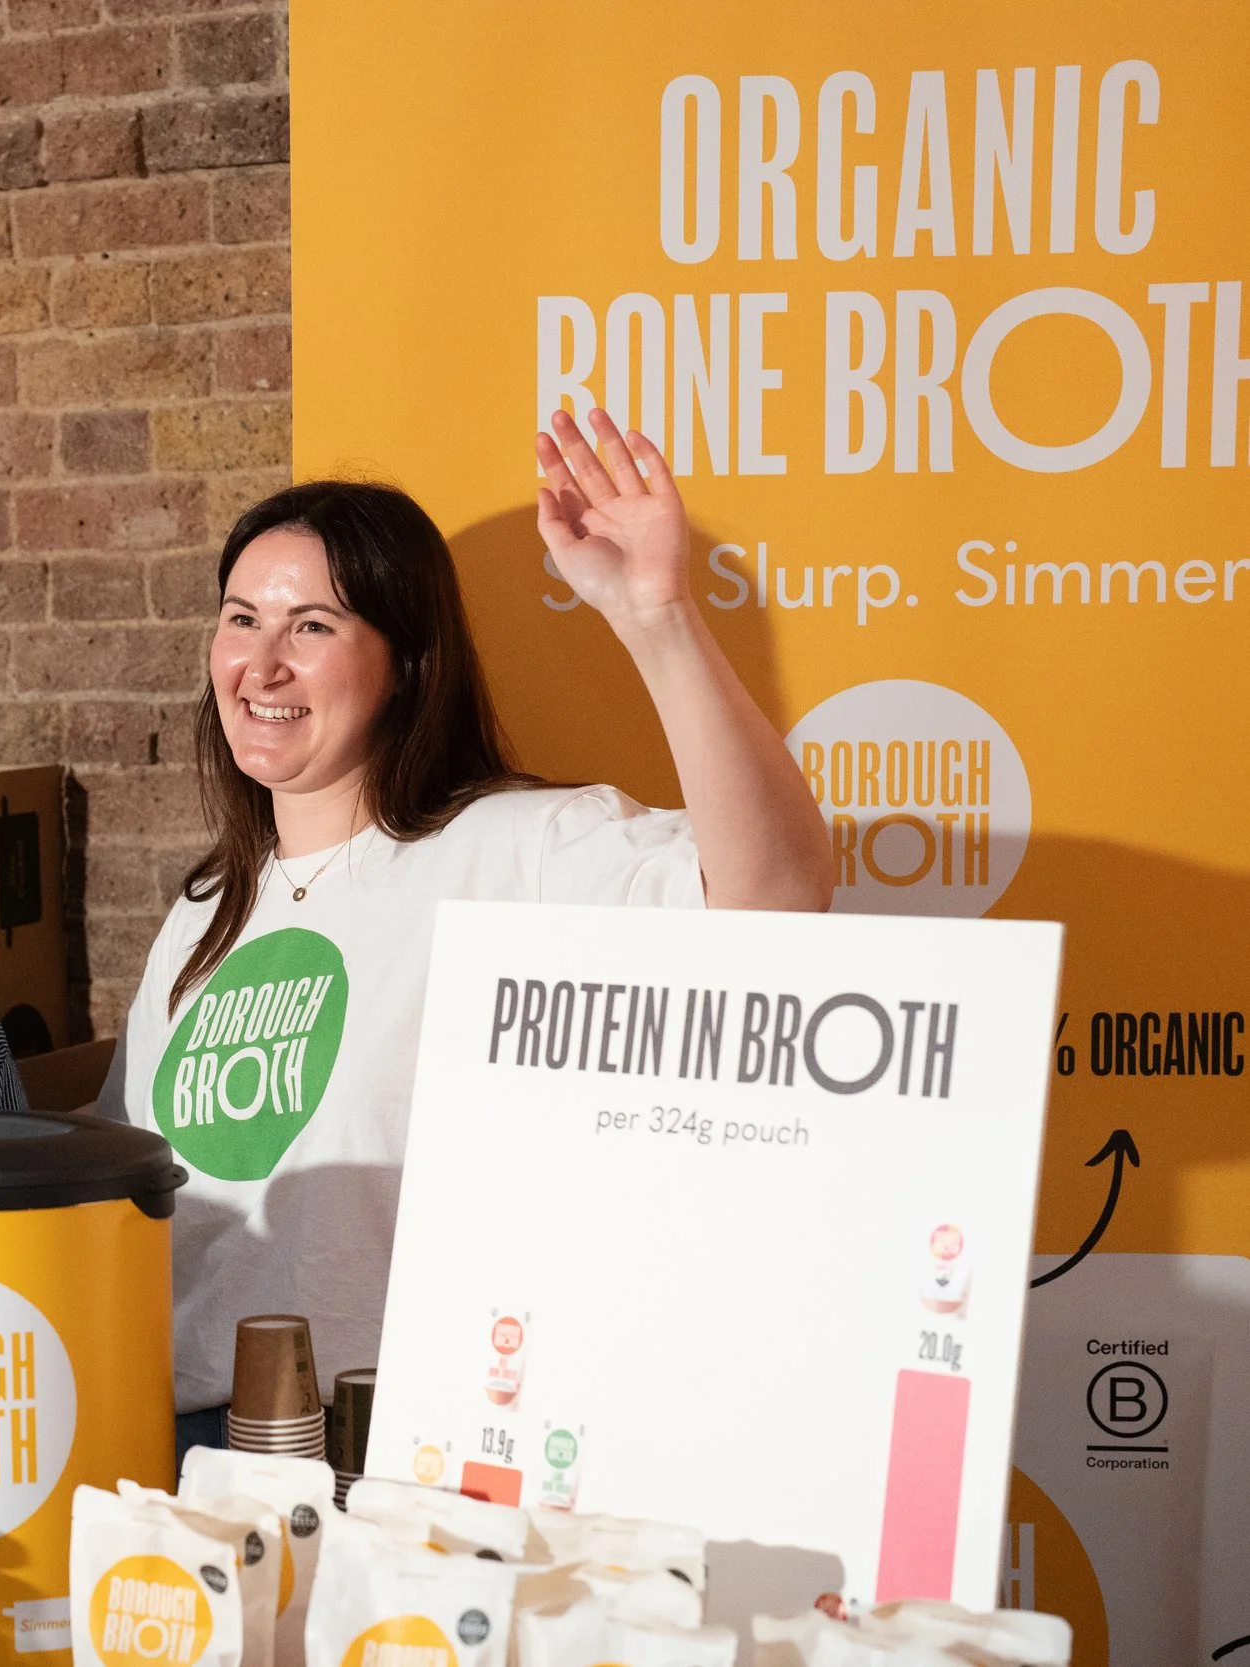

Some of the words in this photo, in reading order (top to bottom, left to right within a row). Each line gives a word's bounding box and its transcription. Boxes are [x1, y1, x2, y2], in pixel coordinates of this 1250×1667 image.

[659, 59, 1161, 265] ORGANIC
[536, 292, 789, 478] BONE
[824, 280, 1250, 475] BROTH
[706, 541, 918, 625] Slurp.
[954, 540, 1250, 608] Simmer
[802, 740, 991, 808] BOROUGH
[833, 813, 990, 887] ROTH
[185, 974, 334, 1053] BOROUGH
[488, 977, 670, 1077] PROTEIN
[678, 988, 728, 1081] IN
[737, 991, 959, 1099] BROTH
[1091, 1011, 1245, 1077] ORGANIC
[173, 1037, 309, 1128] BROTH
[596, 1108, 640, 1135] per
[648, 1105, 715, 1145] 324g
[723, 1117, 810, 1147] pouch
[918, 1330, 963, 1371] 20.0g
[1086, 1338, 1169, 1356] Certified
[1109, 1376, 1148, 1422] B
[480, 1427, 516, 1465] 13.9g
[1086, 1456, 1169, 1472] Corporation
[108, 1575, 196, 1624] BOROUGH
[102, 1612, 196, 1663] BROTH
